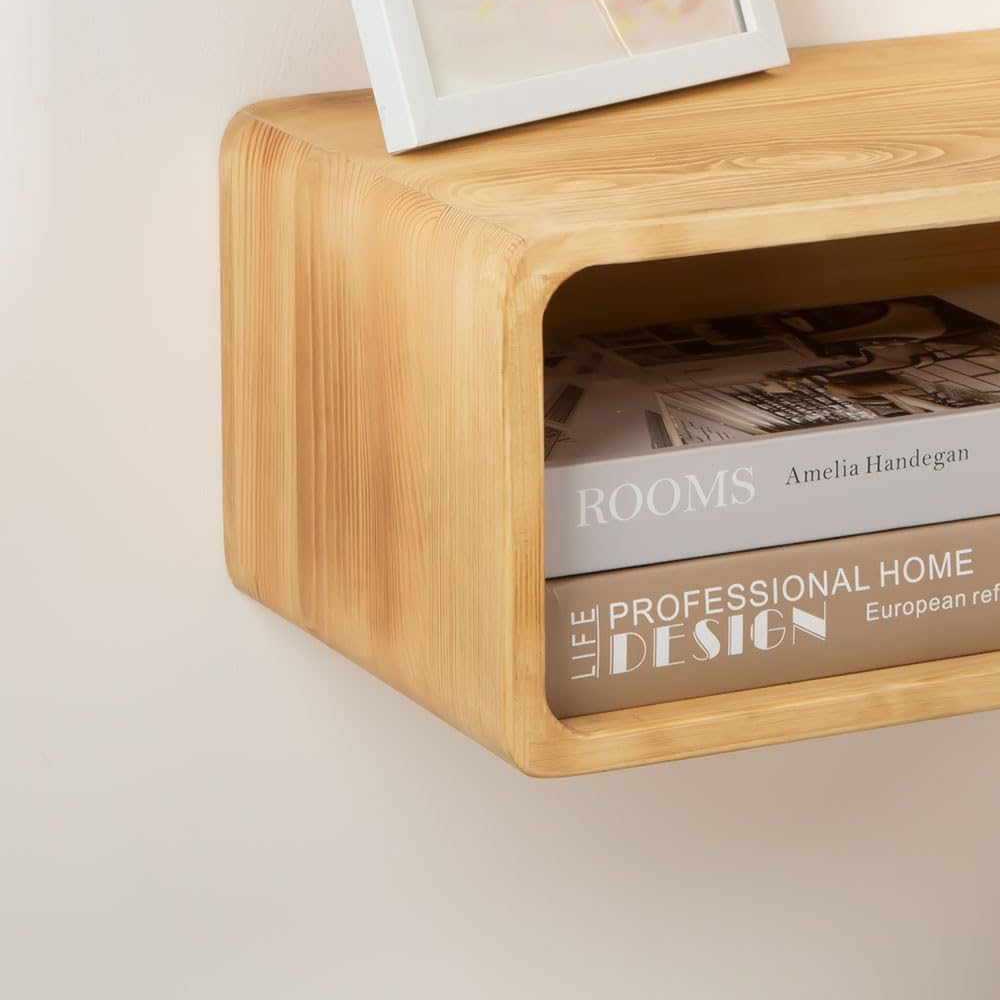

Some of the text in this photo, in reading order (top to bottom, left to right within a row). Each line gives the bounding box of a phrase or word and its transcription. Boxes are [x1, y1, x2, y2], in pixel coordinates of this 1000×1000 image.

[576, 465, 756, 528] ROOMS
[785, 448, 970, 486] Amelia Handegan
[609, 547, 974, 629] PROFESSIONAL HOME
[866, 592, 966, 622] European
[570, 607, 596, 679] LIFE
[609, 601, 827, 676] DESIGN
